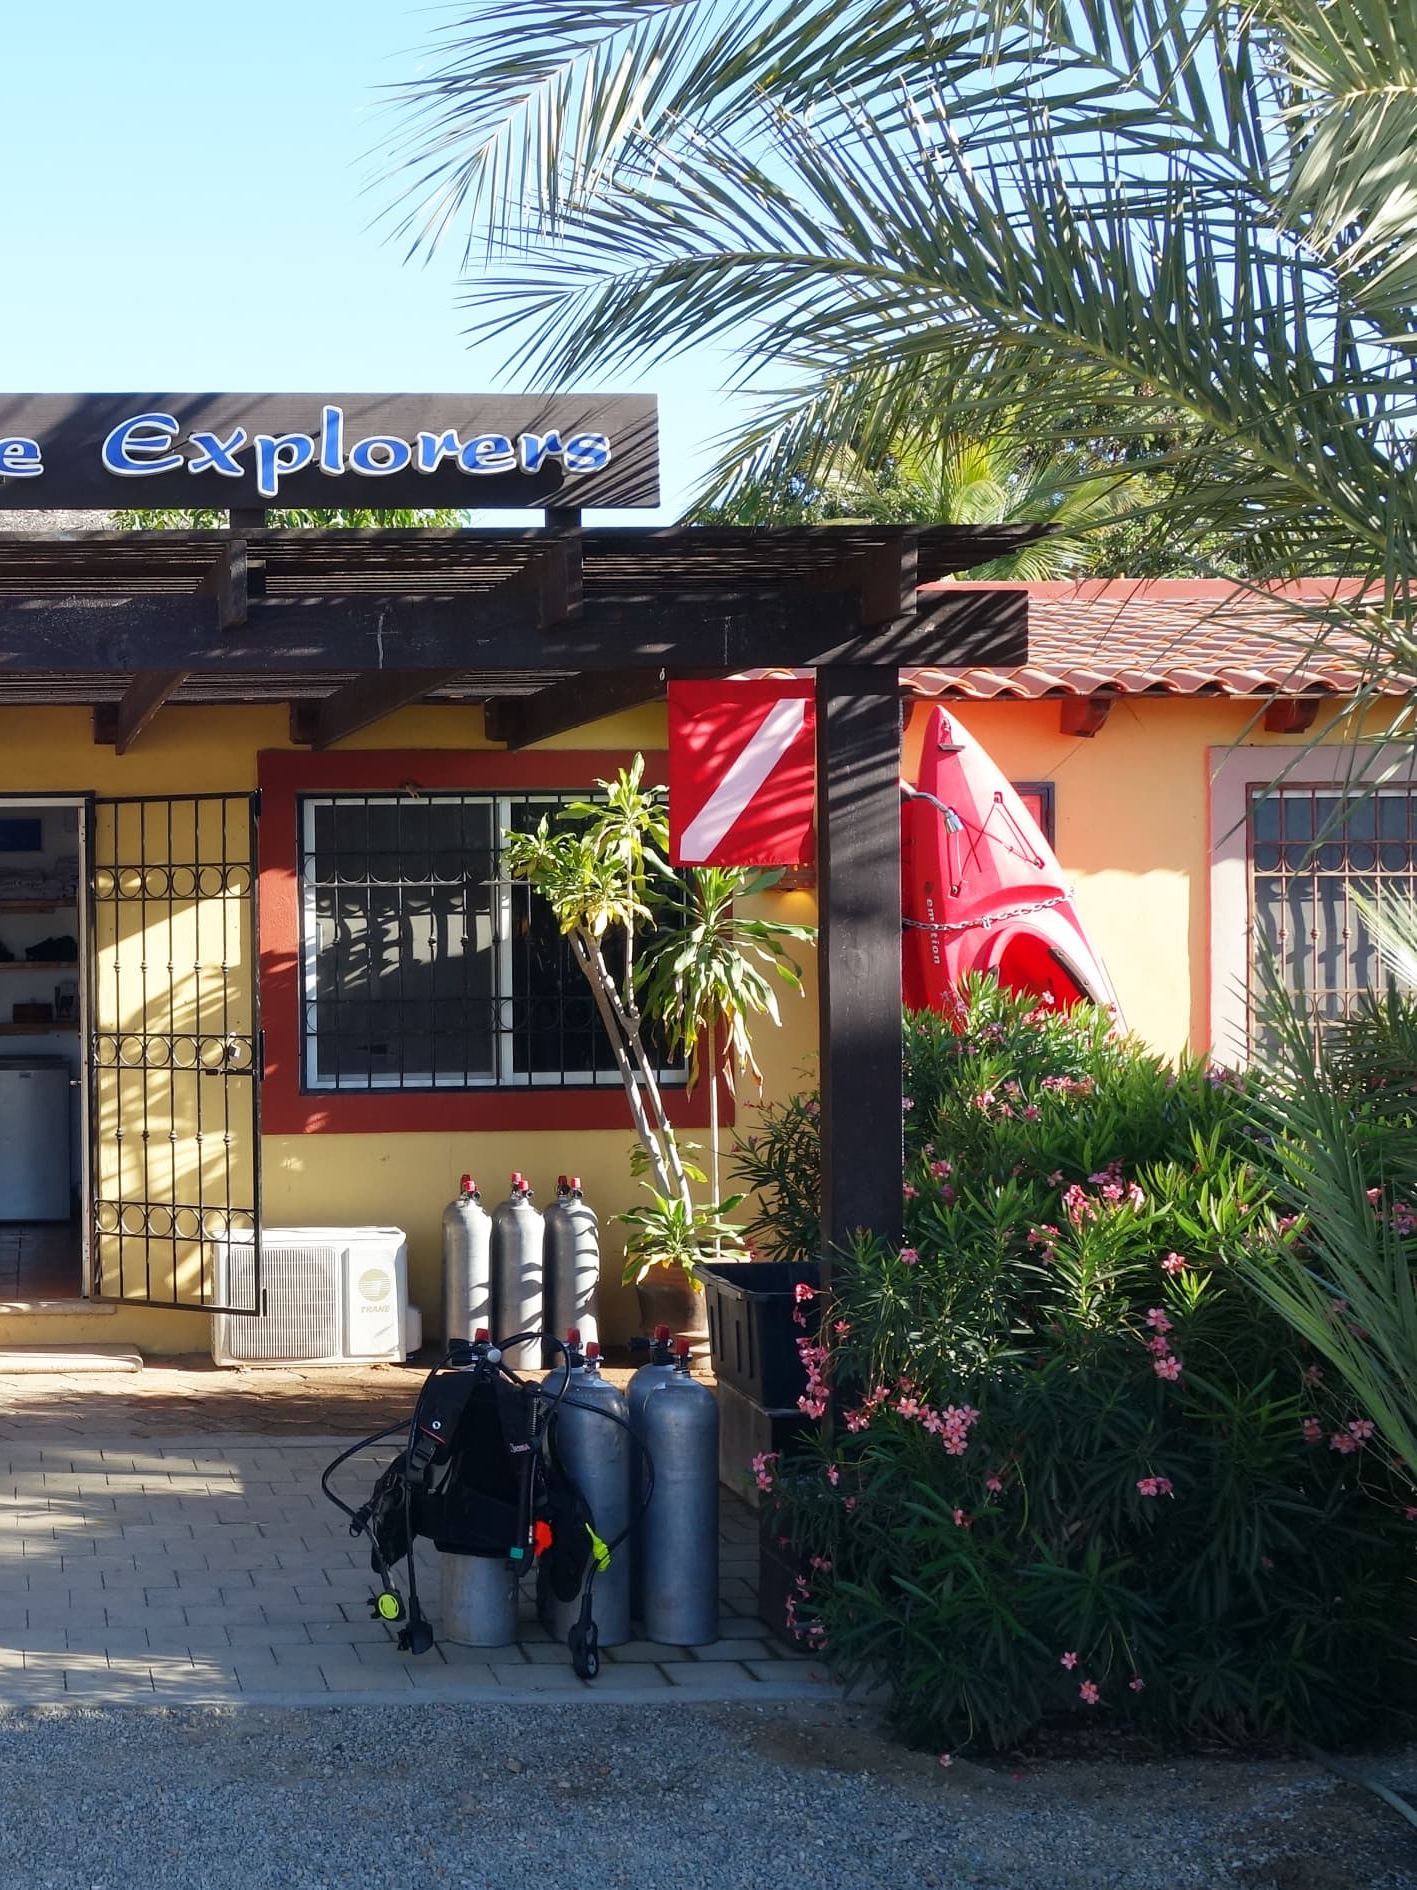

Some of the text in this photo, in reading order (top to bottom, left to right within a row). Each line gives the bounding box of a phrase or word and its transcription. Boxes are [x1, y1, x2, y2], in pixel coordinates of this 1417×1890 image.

[101, 404, 612, 498] Explorers
[927, 899, 940, 964] emtion
[361, 1304, 390, 1313] TRANE
